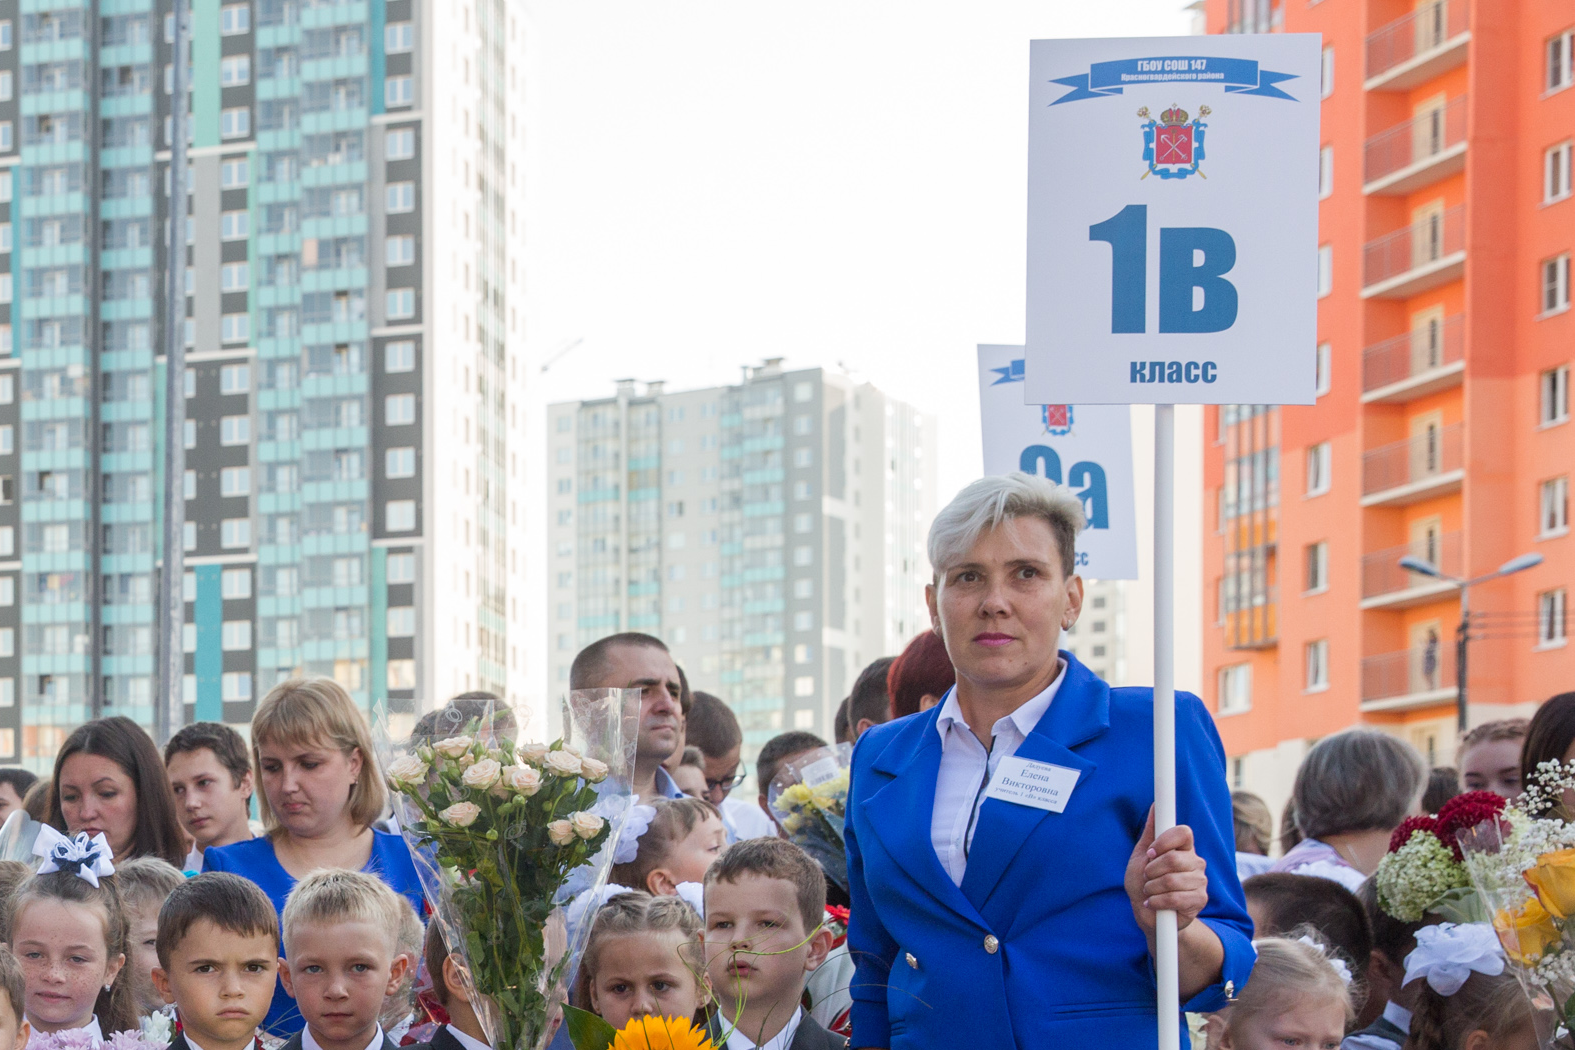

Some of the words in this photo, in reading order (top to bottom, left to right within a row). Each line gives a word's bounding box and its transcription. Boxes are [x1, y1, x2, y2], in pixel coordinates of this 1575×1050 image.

[1138, 60, 1163, 71] ГБОУ
[1164, 60, 1189, 71] СОШ
[1190, 59, 1207, 70] 147
[1121, 72, 1197, 82] Красногвардейского
[1197, 71, 1225, 80] района
[1088, 204, 1239, 334] 1В
[1129, 361, 1218, 384] класс
[1020, 769, 1050, 782] Елена
[1001, 777, 1059, 797] Викторовна
